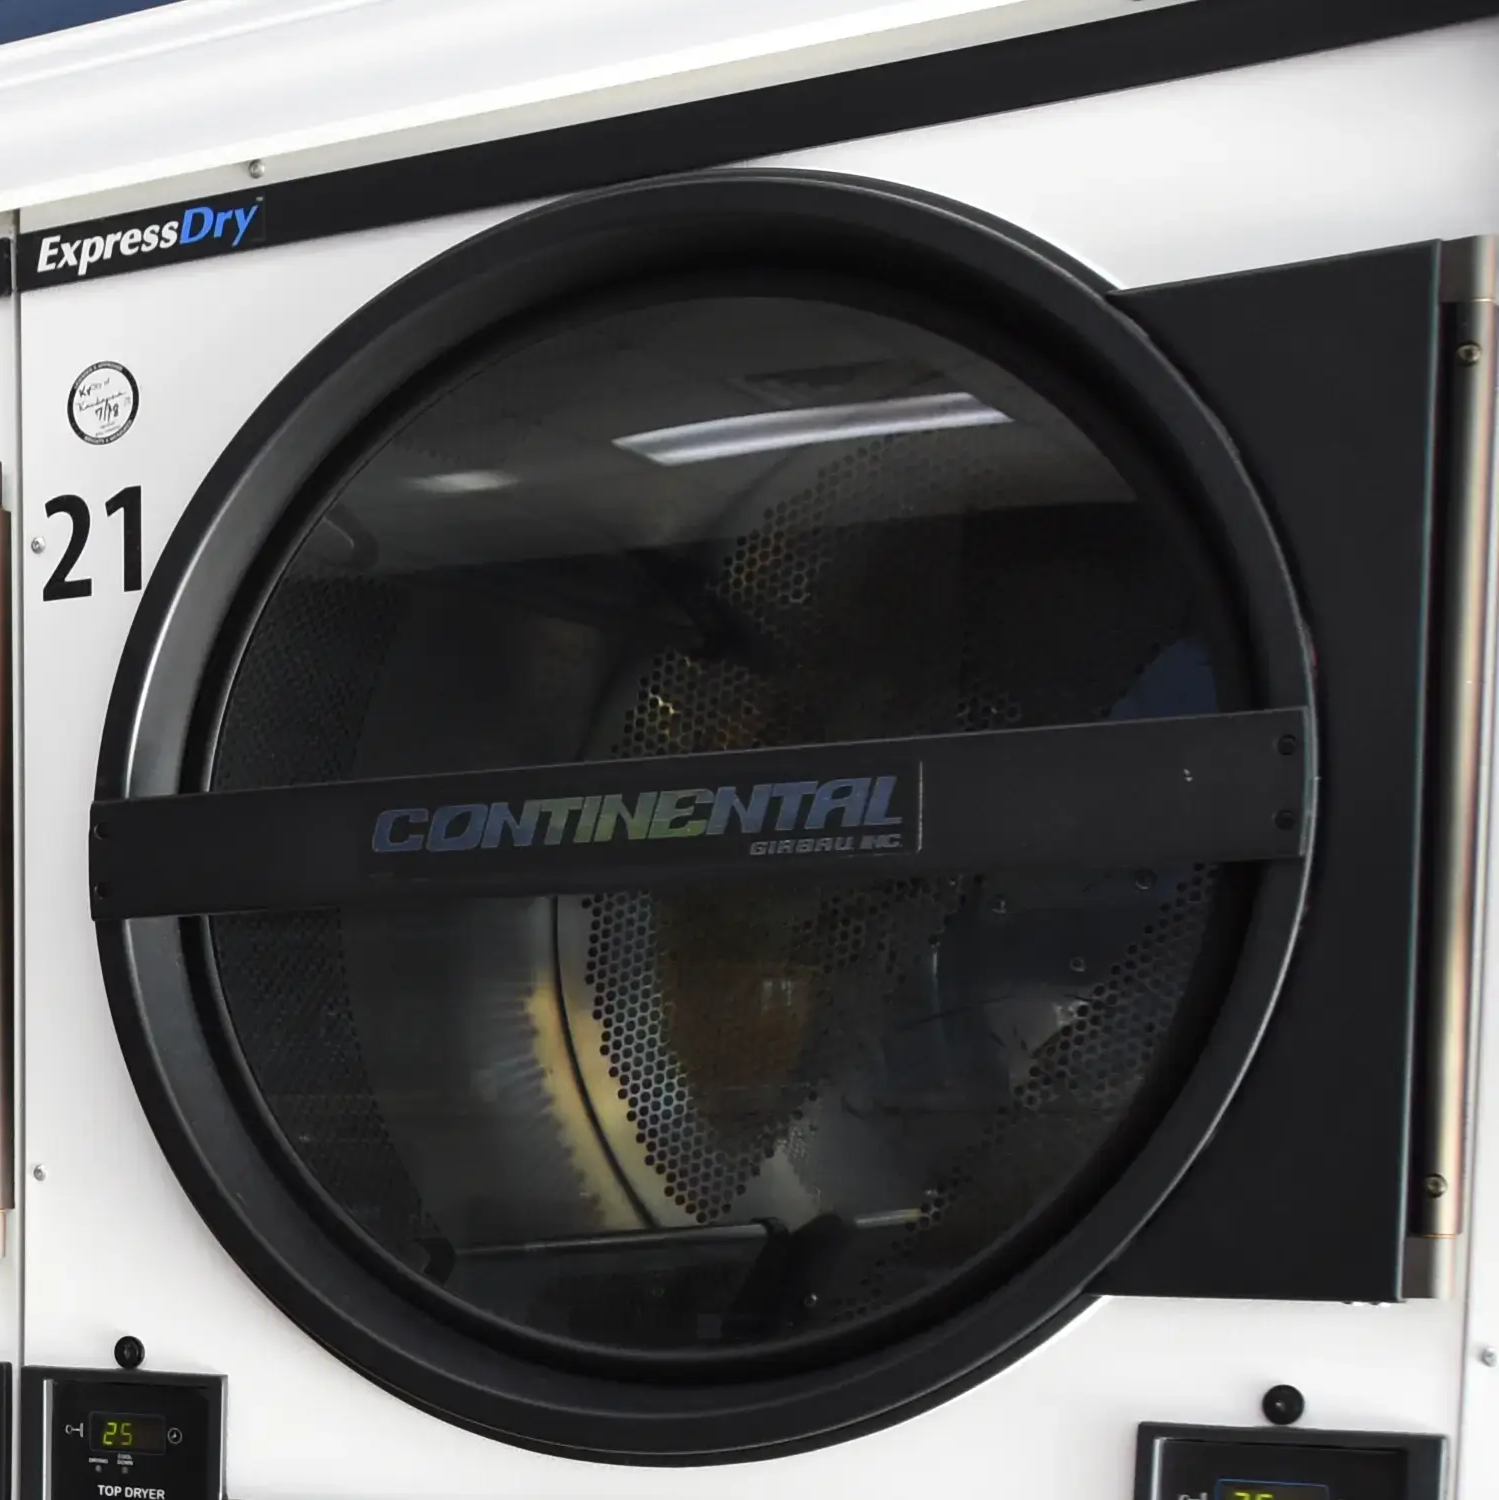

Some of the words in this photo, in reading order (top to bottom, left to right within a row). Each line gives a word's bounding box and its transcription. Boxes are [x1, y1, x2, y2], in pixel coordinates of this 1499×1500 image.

[35, 201, 259, 276] ExpressDry
[42, 485, 142, 601] 21
[371, 775, 904, 853] CONTINENTAL
[103, 1422, 133, 1446] 25
[97, 1484, 122, 1498] TOP
[124, 1487, 166, 1500] DRYER
